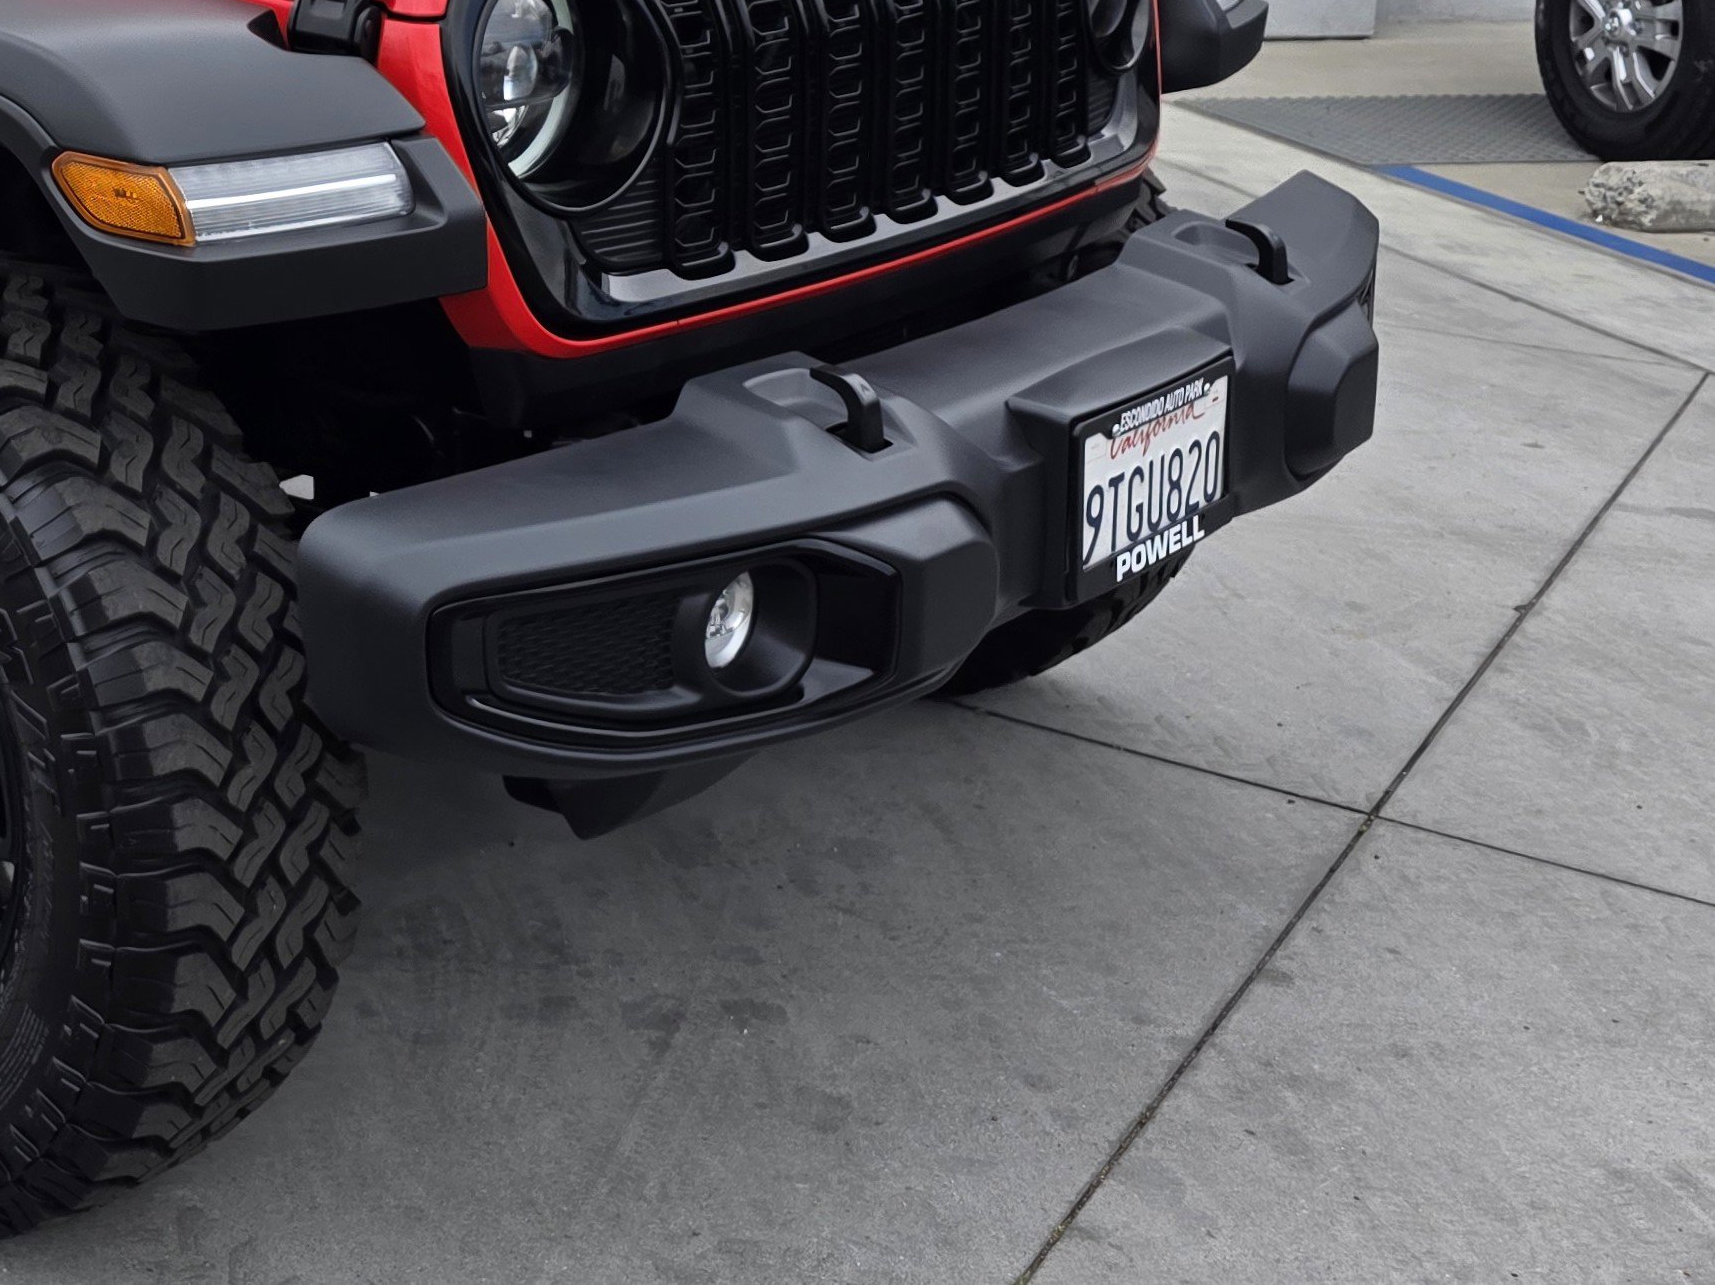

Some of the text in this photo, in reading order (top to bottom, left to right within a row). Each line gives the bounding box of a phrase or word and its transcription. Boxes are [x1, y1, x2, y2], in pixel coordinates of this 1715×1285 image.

[1110, 404, 1206, 460] California
[1120, 378, 1204, 432] ESCONDIDO AUTO PARK
[1082, 430, 1220, 566] 9TGU820
[1116, 515, 1205, 582] POWELL
